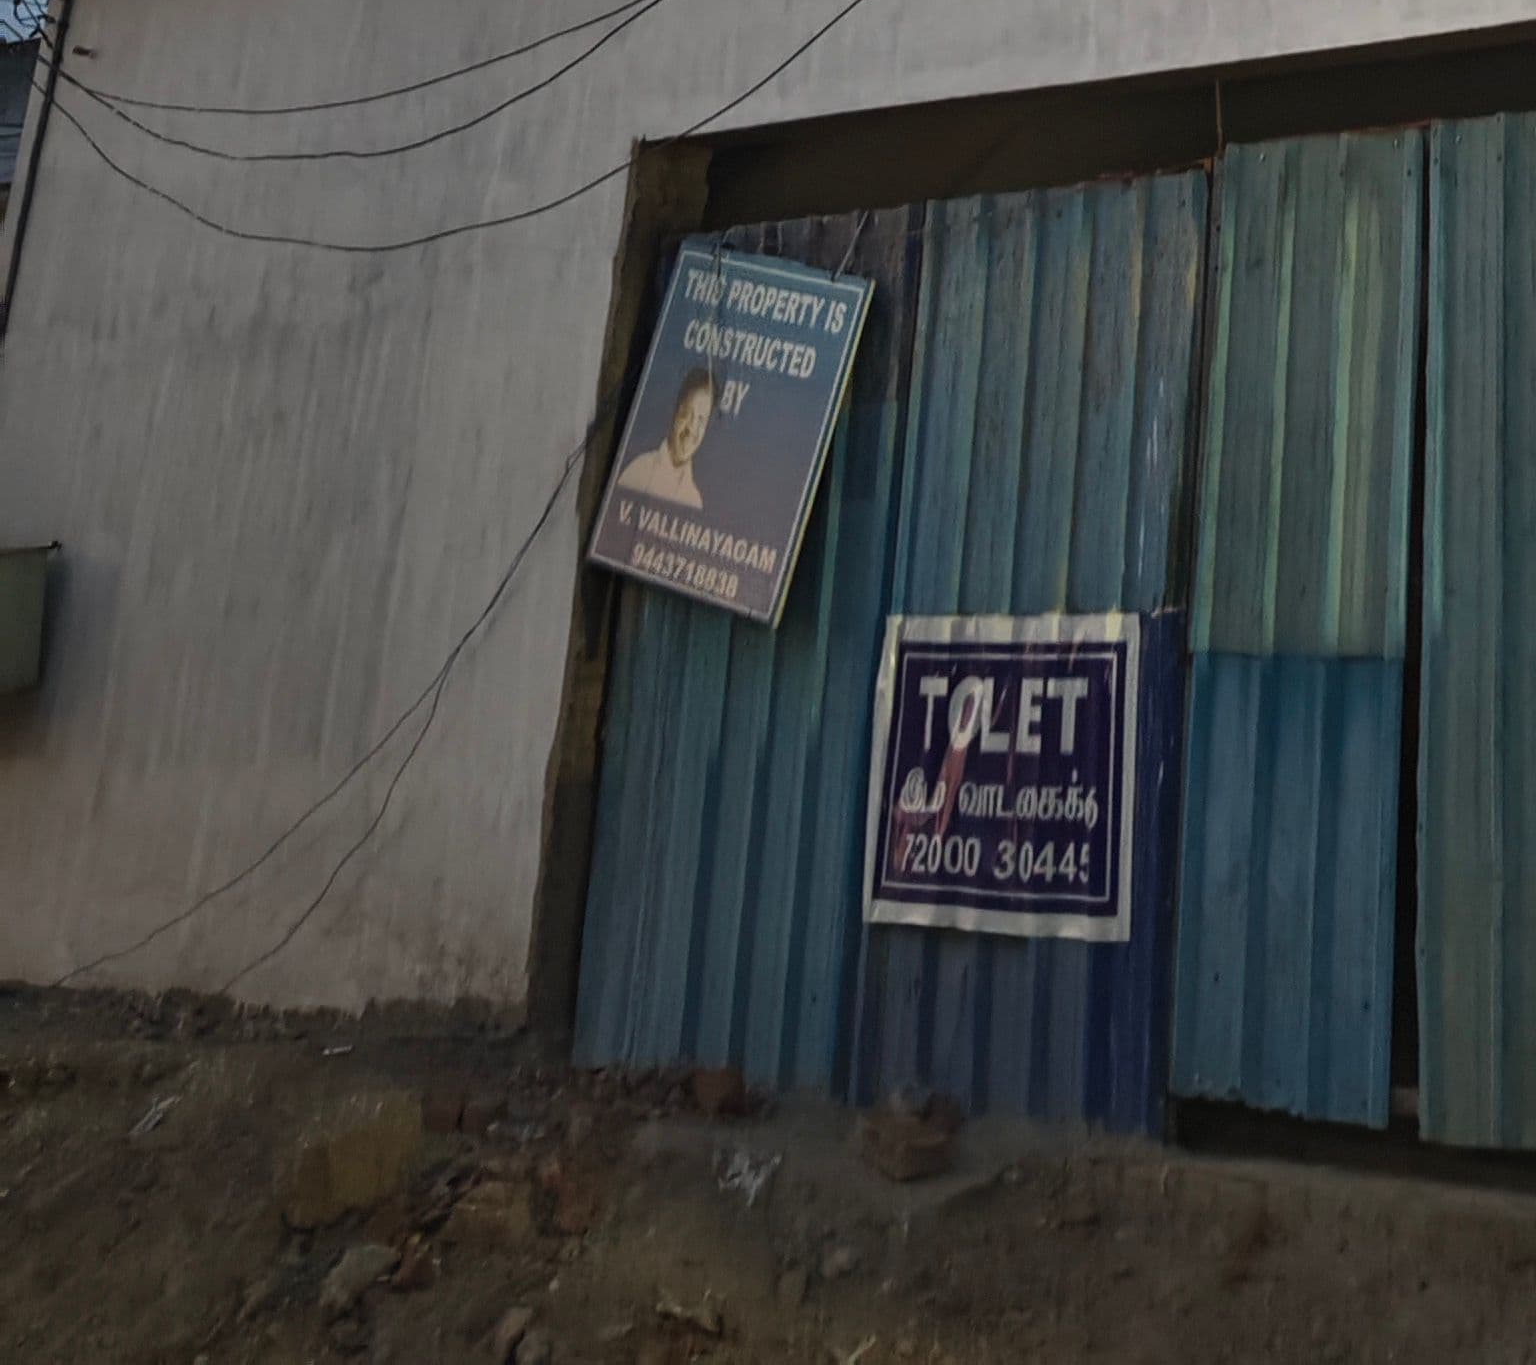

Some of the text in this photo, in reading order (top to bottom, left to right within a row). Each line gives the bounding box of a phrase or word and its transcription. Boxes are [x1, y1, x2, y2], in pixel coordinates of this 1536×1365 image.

[685, 268, 848, 334] THIS PROPERTY IS
[683, 318, 817, 379] CONSTRUCTED
[720, 380, 751, 416] BY
[901, 833, 982, 878] 72000
